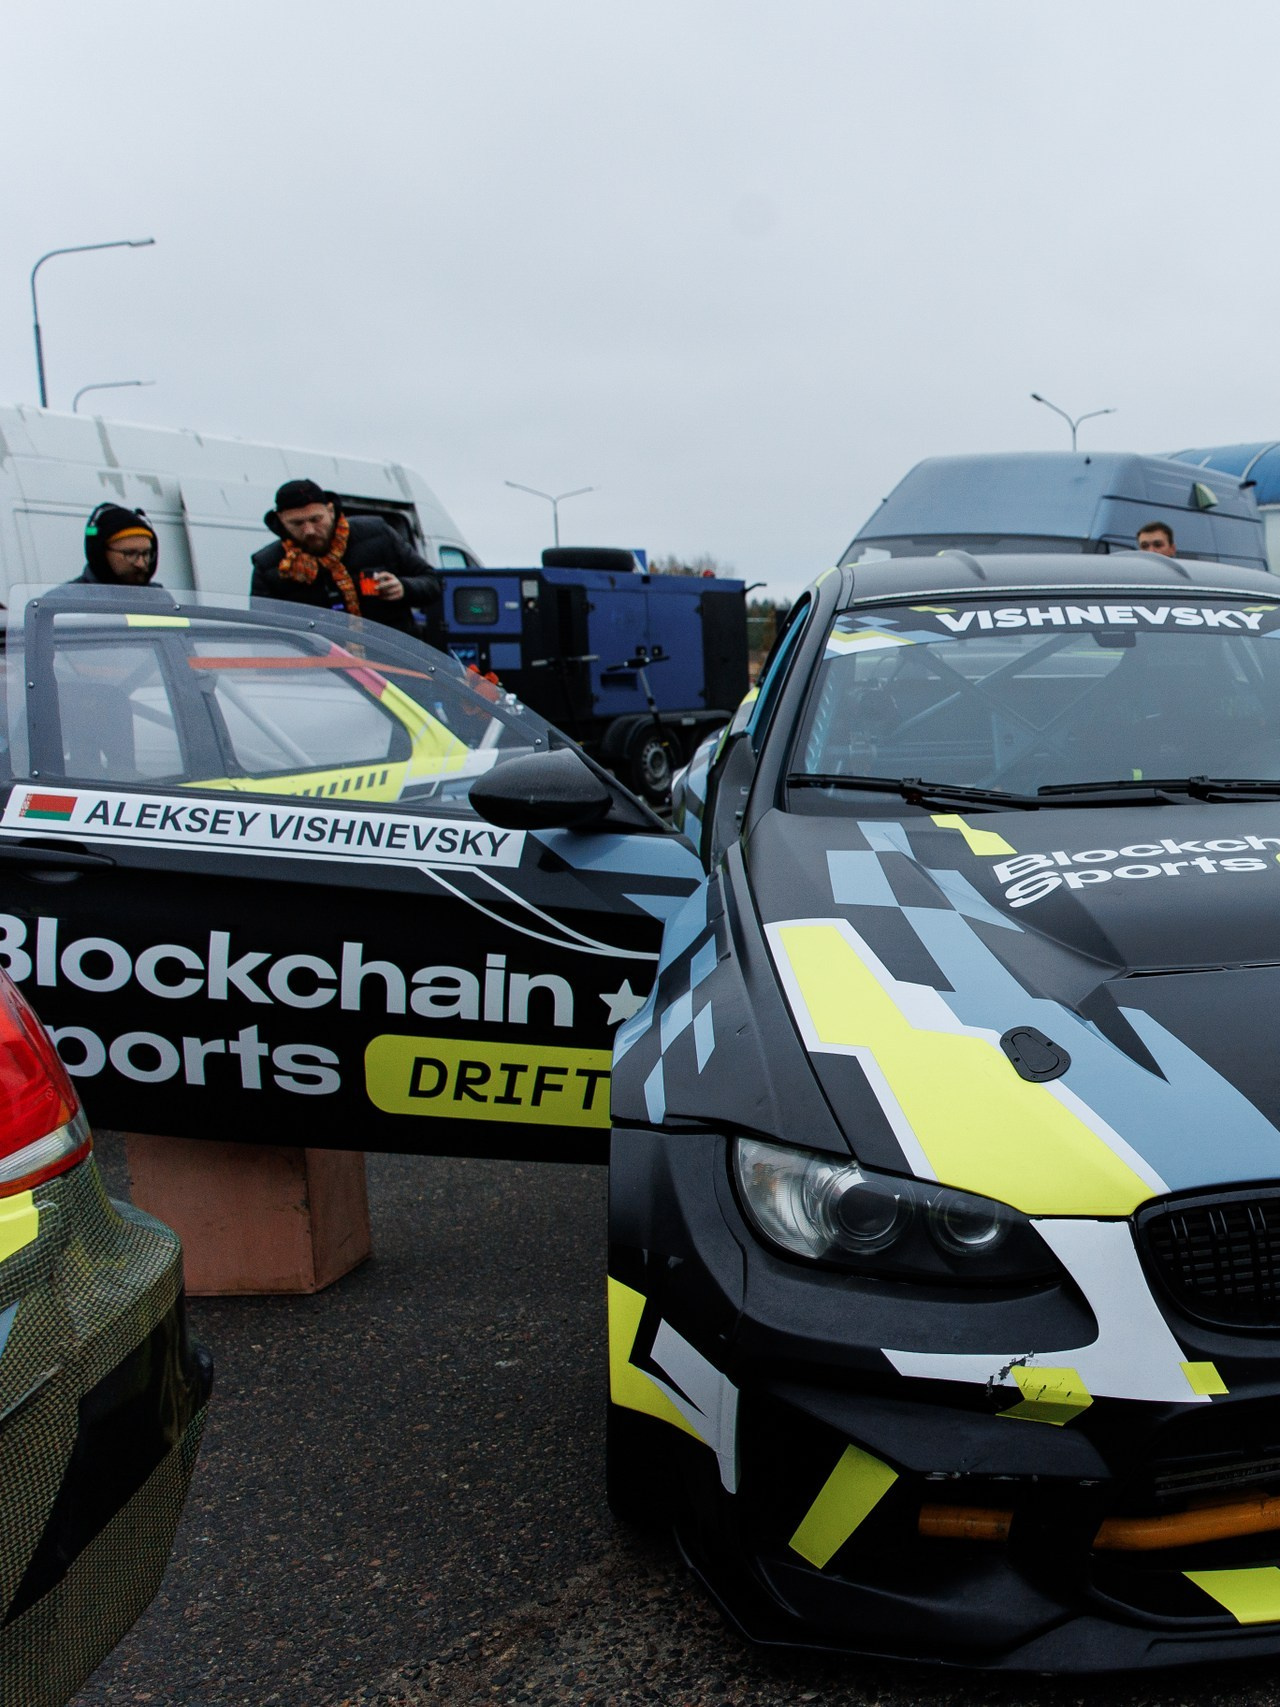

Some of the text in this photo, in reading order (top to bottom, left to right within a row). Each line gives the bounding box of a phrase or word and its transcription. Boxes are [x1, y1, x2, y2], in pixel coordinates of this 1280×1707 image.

[935, 605, 1264, 632] VISHNEVSKY
[84, 799, 512, 858] ALEKSEY VISHNEVSKY
[1005, 853, 1268, 909] Sports
[43, 1023, 612, 1111] ports DRIFT
